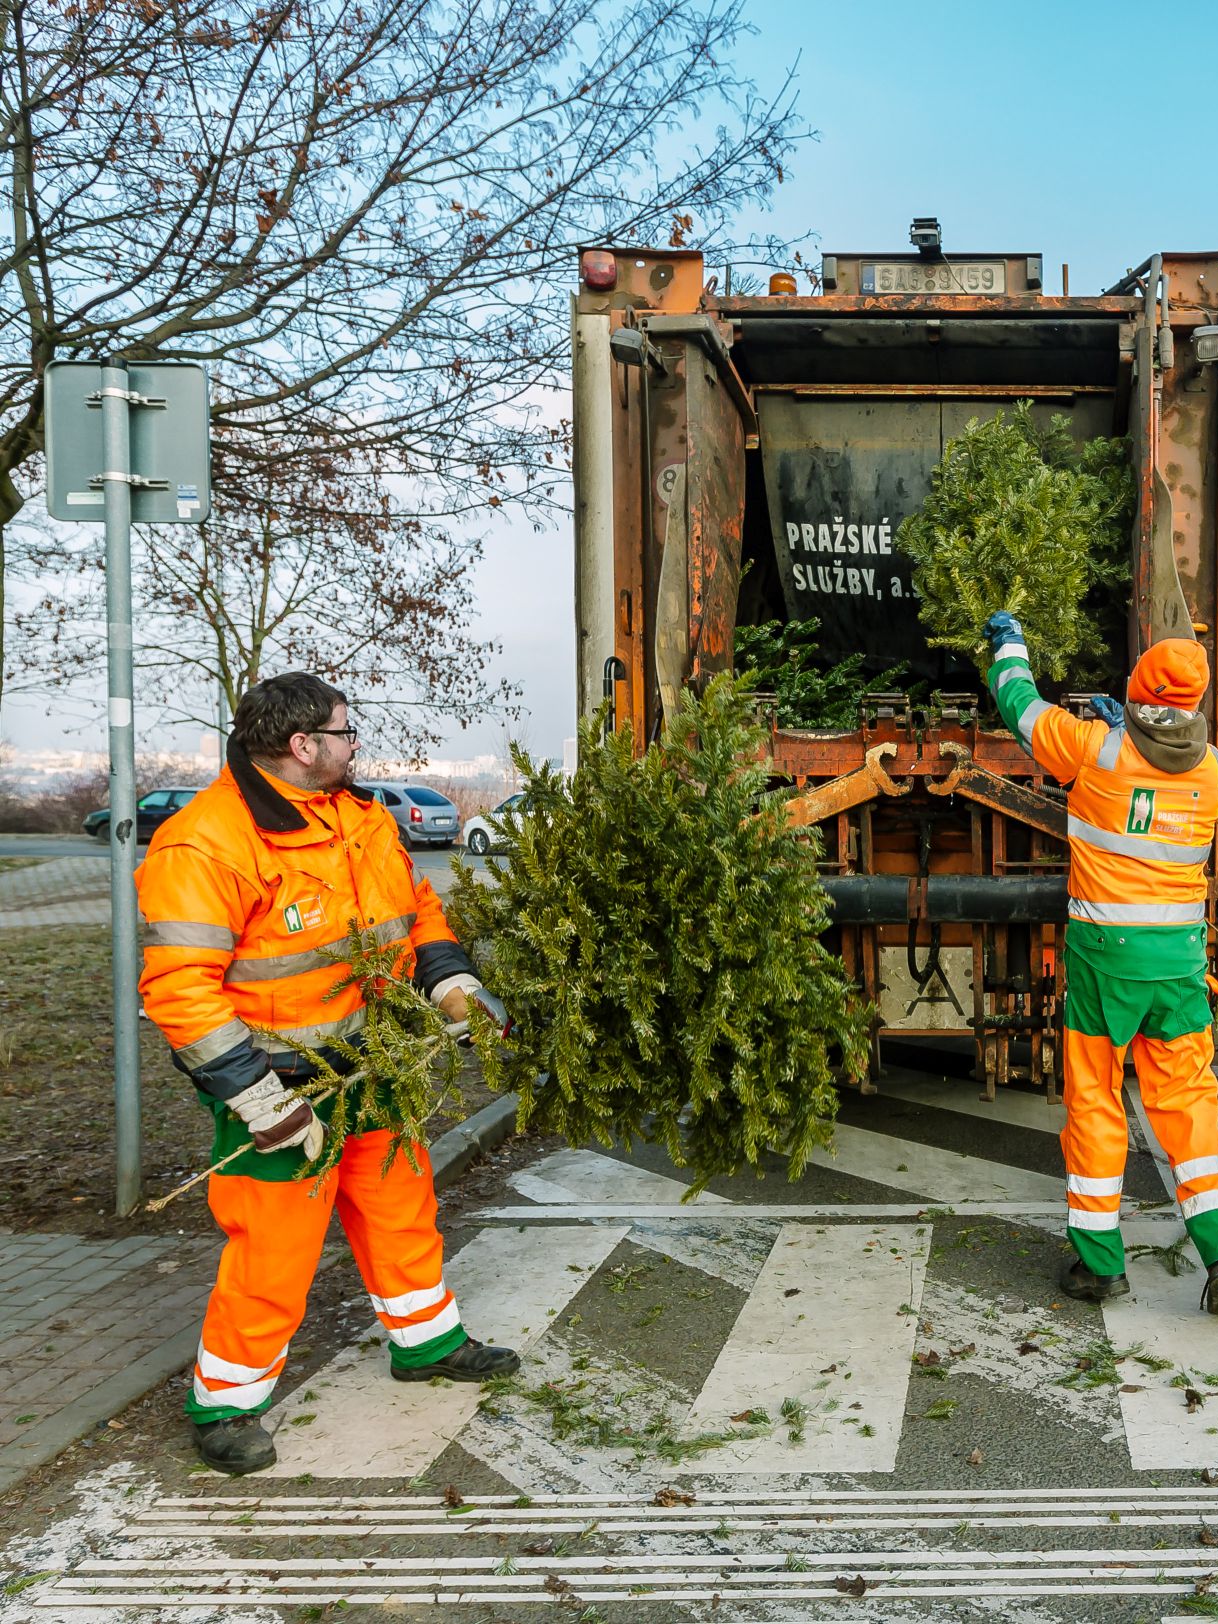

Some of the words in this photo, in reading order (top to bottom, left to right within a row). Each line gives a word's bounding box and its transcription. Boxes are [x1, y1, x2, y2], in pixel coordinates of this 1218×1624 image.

[862, 282, 874, 290] CZ
[786, 516, 892, 555] PRAŽSKÉ
[792, 560, 882, 601] SLUŽBY,
[906, 957, 966, 1017] A
